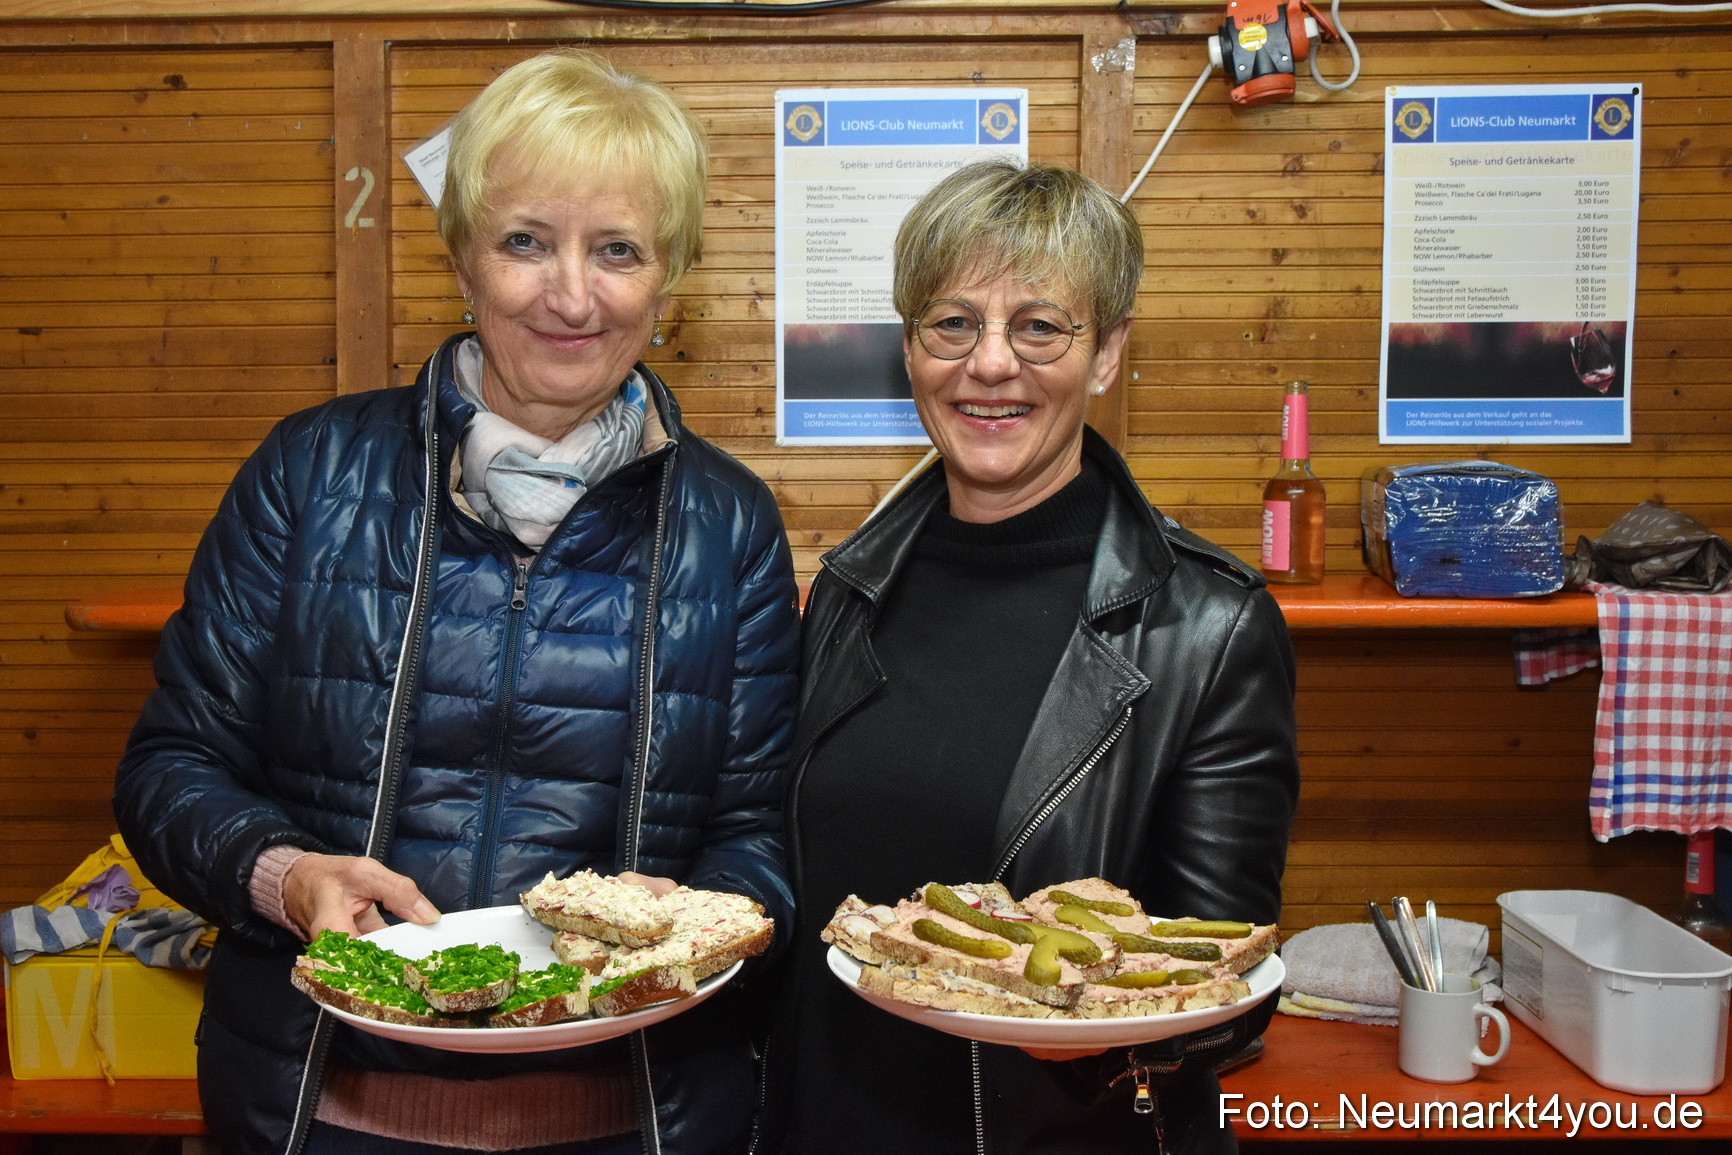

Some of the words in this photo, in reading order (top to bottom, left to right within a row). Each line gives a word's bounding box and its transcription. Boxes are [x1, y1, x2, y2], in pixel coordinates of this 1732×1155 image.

[841, 120, 904, 131] LIONS-Club
[908, 120, 964, 130] Neumarkt
[1451, 116, 1515, 128] LIONS-Club
[1518, 116, 1576, 126] Neumarkt
[840, 161, 872, 169] Speise-
[876, 160, 893, 169] und
[896, 160, 963, 169] Getränkekarte
[1449, 158, 1482, 166] Speise-
[1485, 157, 1503, 165] und
[1506, 157, 1575, 165] Getränkekarte
[345, 166, 375, 228] 2
[1511, 411, 1528, 419] geht
[1475, 419, 1524, 428] Unterstützung
[16, 967, 116, 1068] M
